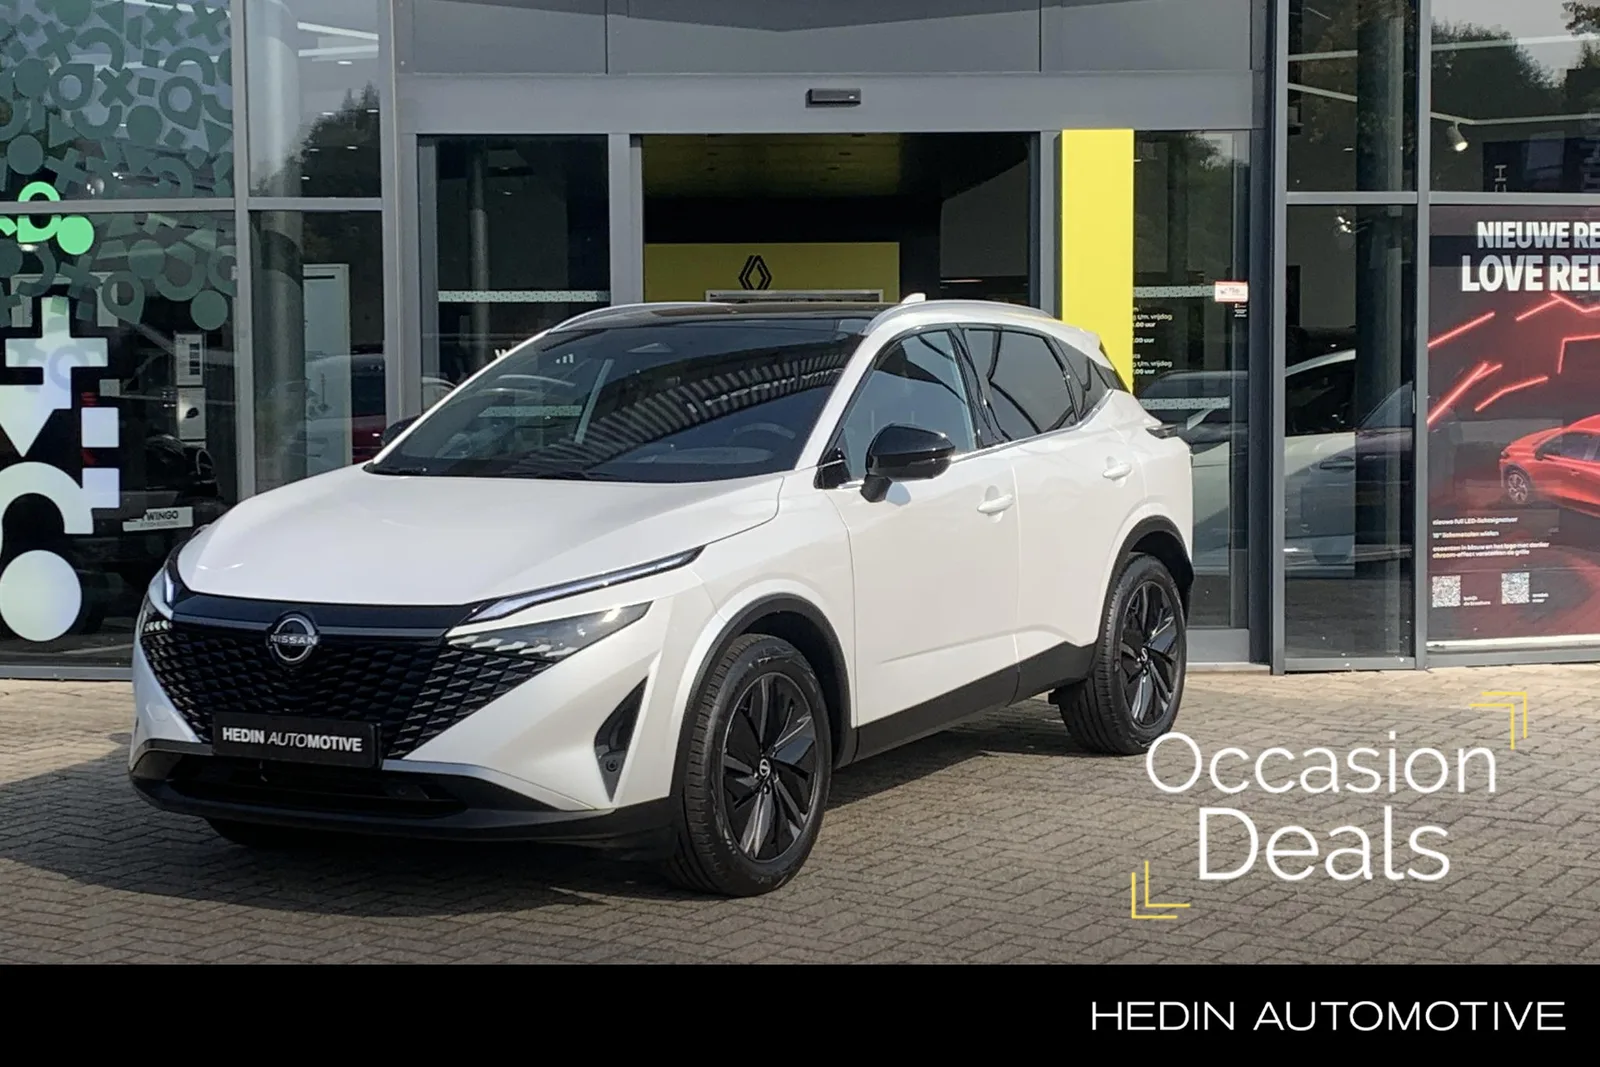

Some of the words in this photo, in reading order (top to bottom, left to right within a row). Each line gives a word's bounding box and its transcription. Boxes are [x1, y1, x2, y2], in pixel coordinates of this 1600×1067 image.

[1477, 221, 1570, 249] NIEUWE
[1461, 254, 1544, 292] LOVE
[143, 510, 179, 521] WINGO
[270, 634, 318, 646] NISSAN
[222, 727, 265, 744] HEDIN
[267, 731, 362, 752] AUTOMOTIVE
